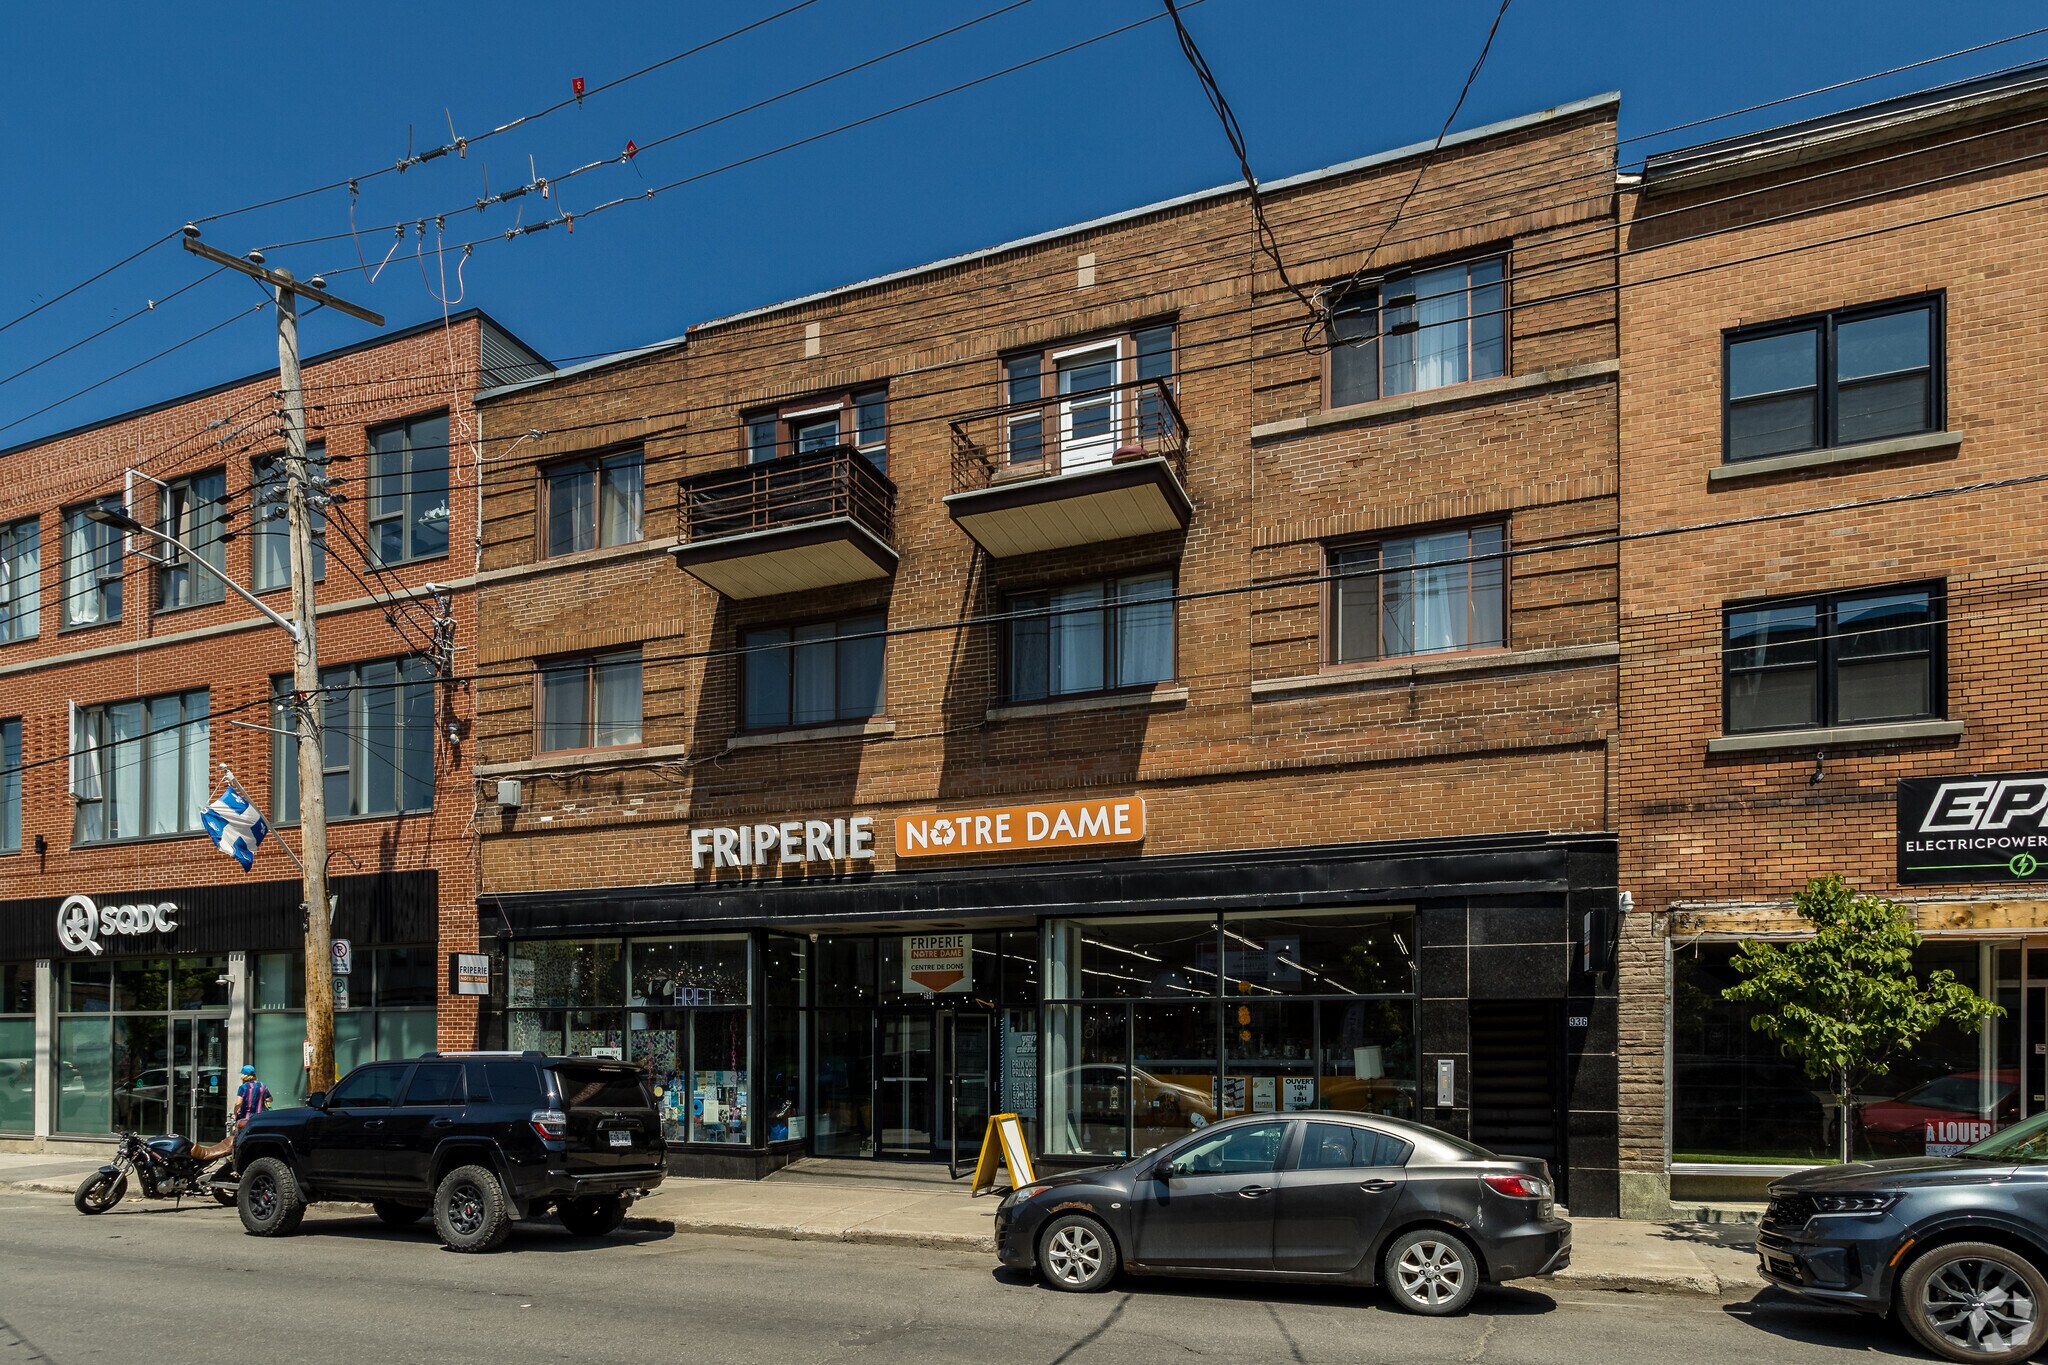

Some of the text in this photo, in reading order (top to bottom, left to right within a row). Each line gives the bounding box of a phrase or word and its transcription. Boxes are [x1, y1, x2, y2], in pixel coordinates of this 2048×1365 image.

[1919, 778, 2048, 832] EP
[906, 804, 1132, 850] NOTRE DAME
[691, 817, 875, 869] FRIPERIE
[100, 902, 178, 936] SQDC
[911, 936, 964, 949] FRIPERIE
[913, 949, 962, 958] NOTRE DAME
[460, 966, 488, 975] FRIPERIE
[1569, 1017, 1587, 1026] 936
[1926, 1122, 1991, 1143] À LOUER
